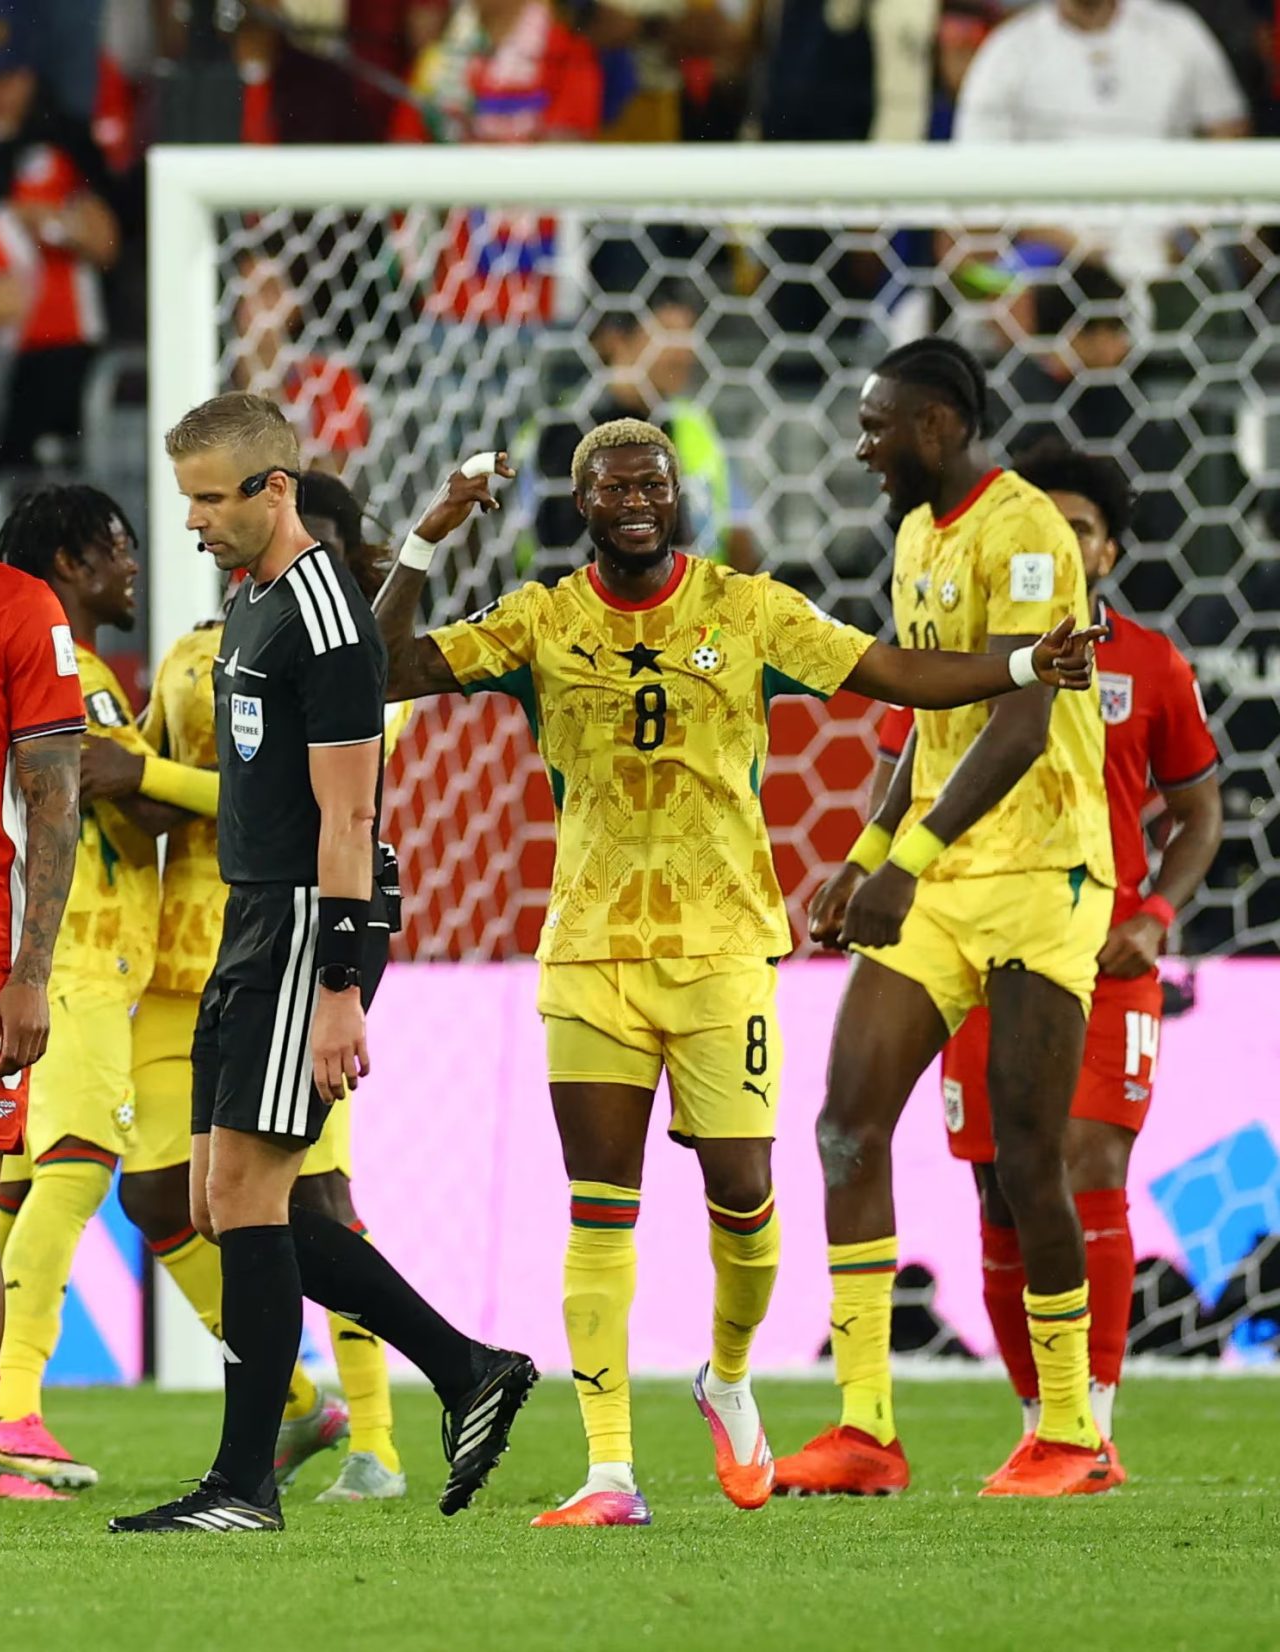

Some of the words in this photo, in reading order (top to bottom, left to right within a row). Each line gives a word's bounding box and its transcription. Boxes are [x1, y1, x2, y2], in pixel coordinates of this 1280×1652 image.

[233, 699, 258, 717] FIFA
[234, 724, 260, 735] REFEREE
[633, 684, 667, 751] 8
[745, 1015, 767, 1076] 8
[1125, 1010, 1159, 1084] 14
